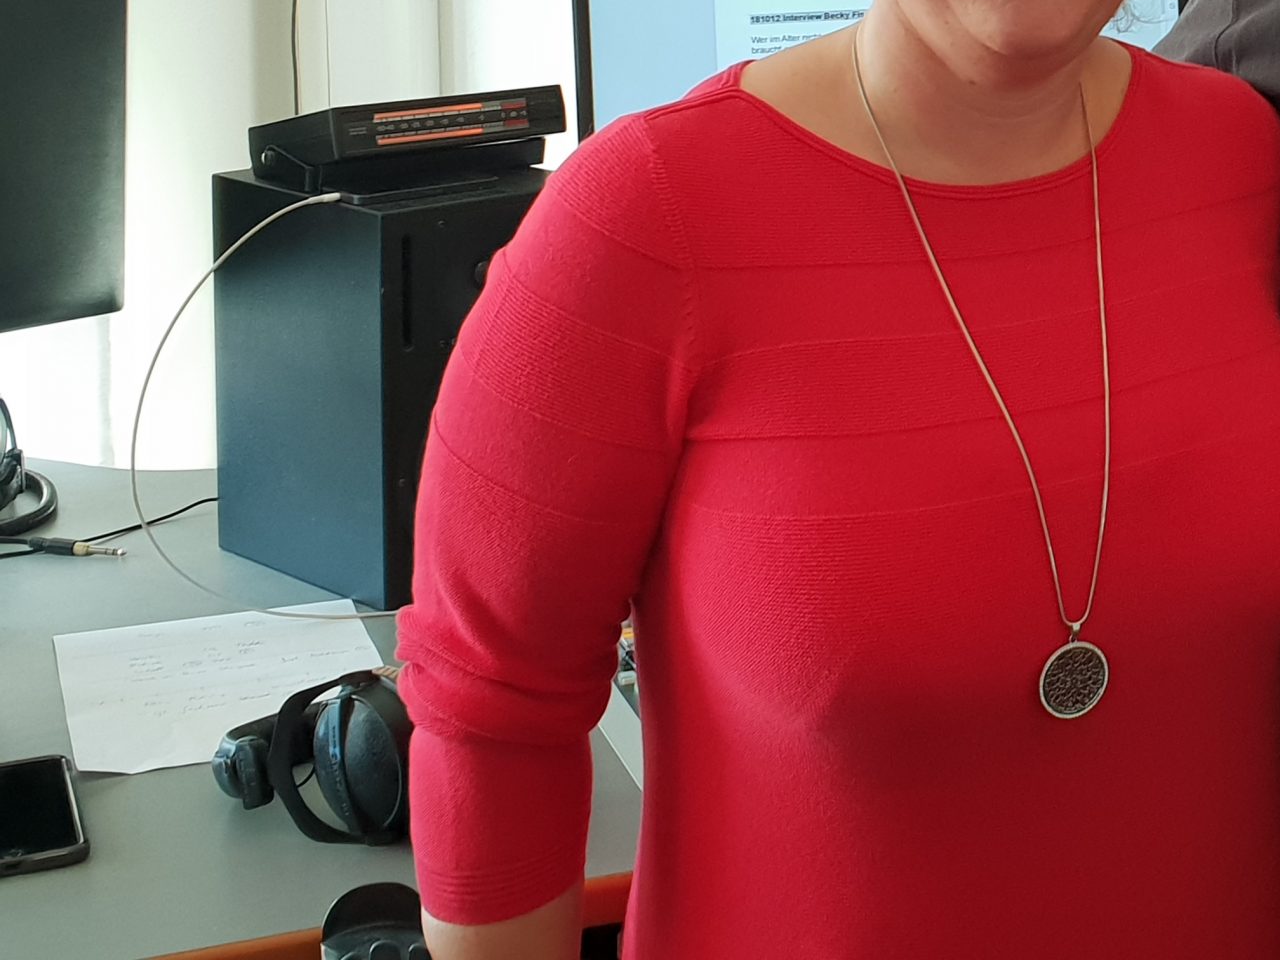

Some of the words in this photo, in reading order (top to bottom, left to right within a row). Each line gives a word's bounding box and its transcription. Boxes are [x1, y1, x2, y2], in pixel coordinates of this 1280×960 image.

[750, 15, 781, 24] 181012
[783, 14, 822, 22] Interview
[824, 11, 850, 20] Becky
[751, 36, 768, 44] Wer
